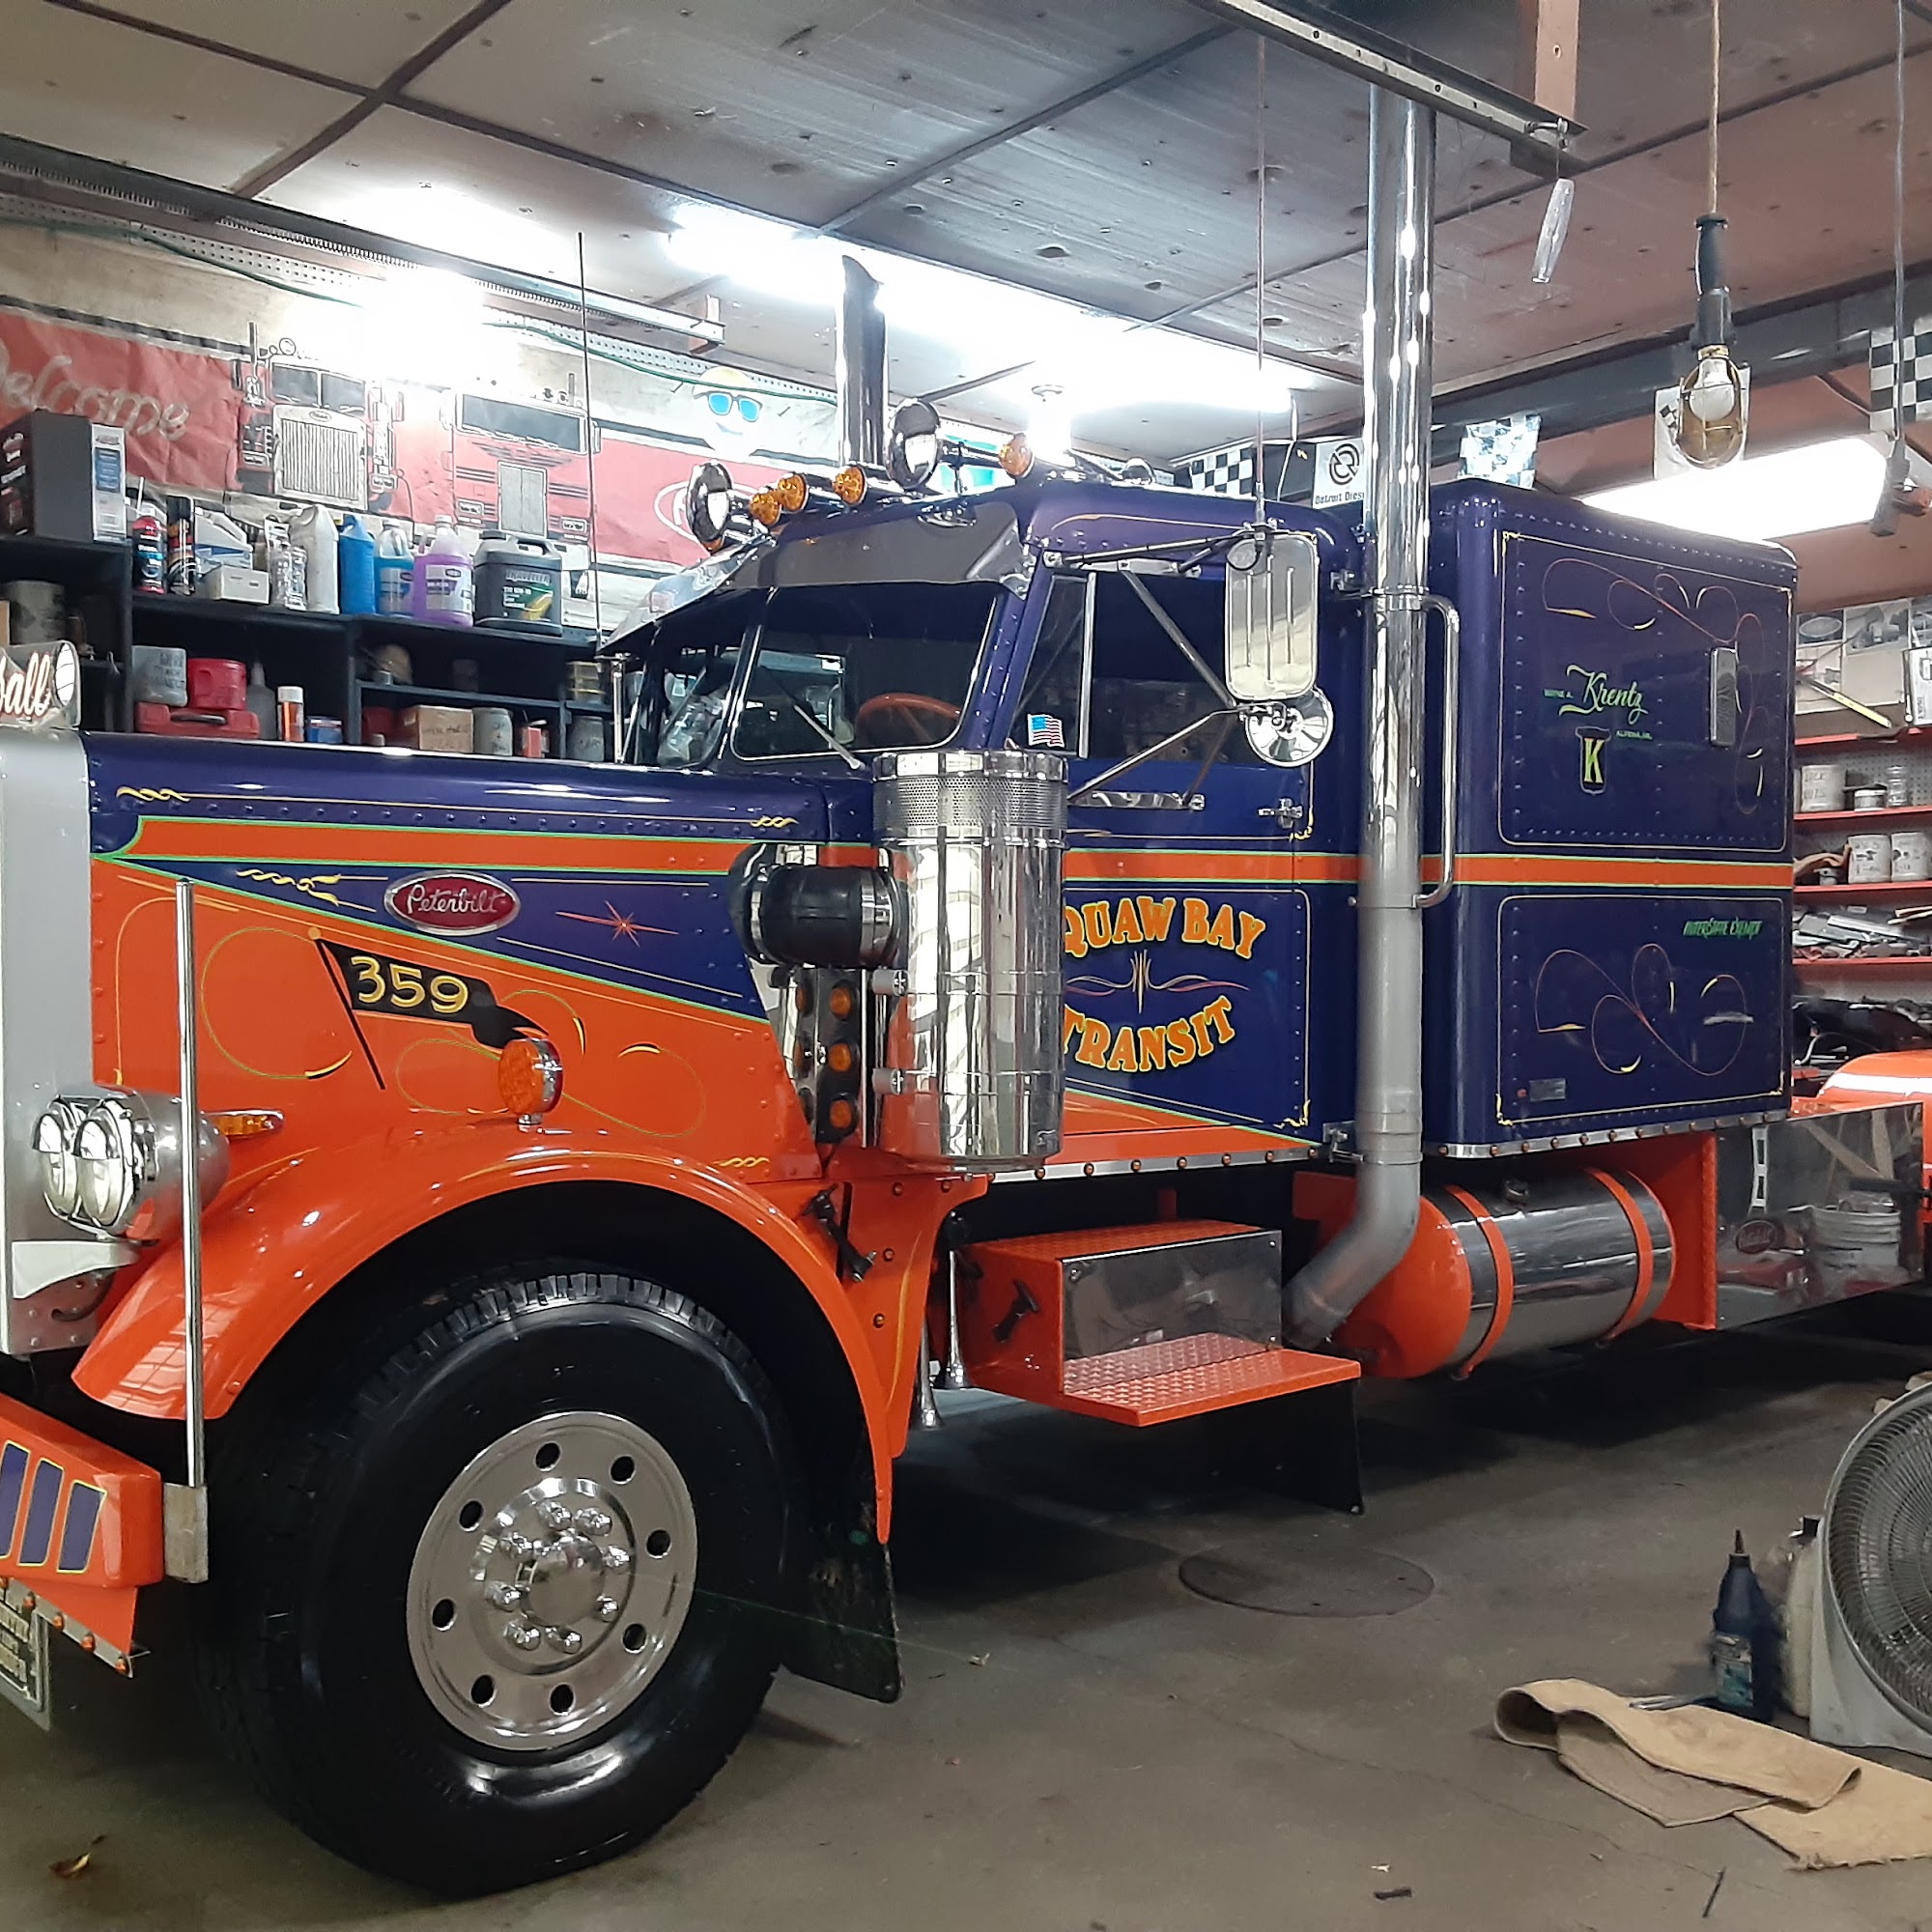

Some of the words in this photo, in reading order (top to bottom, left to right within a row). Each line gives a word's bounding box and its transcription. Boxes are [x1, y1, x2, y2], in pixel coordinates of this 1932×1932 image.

[0, 342, 190, 441] elcome
[1558, 664, 1648, 725] Krentz
[1583, 737, 1605, 783] K
[406, 883, 506, 914] Peterbilt
[1181, 897, 1265, 959] BAY
[350, 954, 469, 1014] 359
[1064, 995, 1235, 1072] TRANSIT
